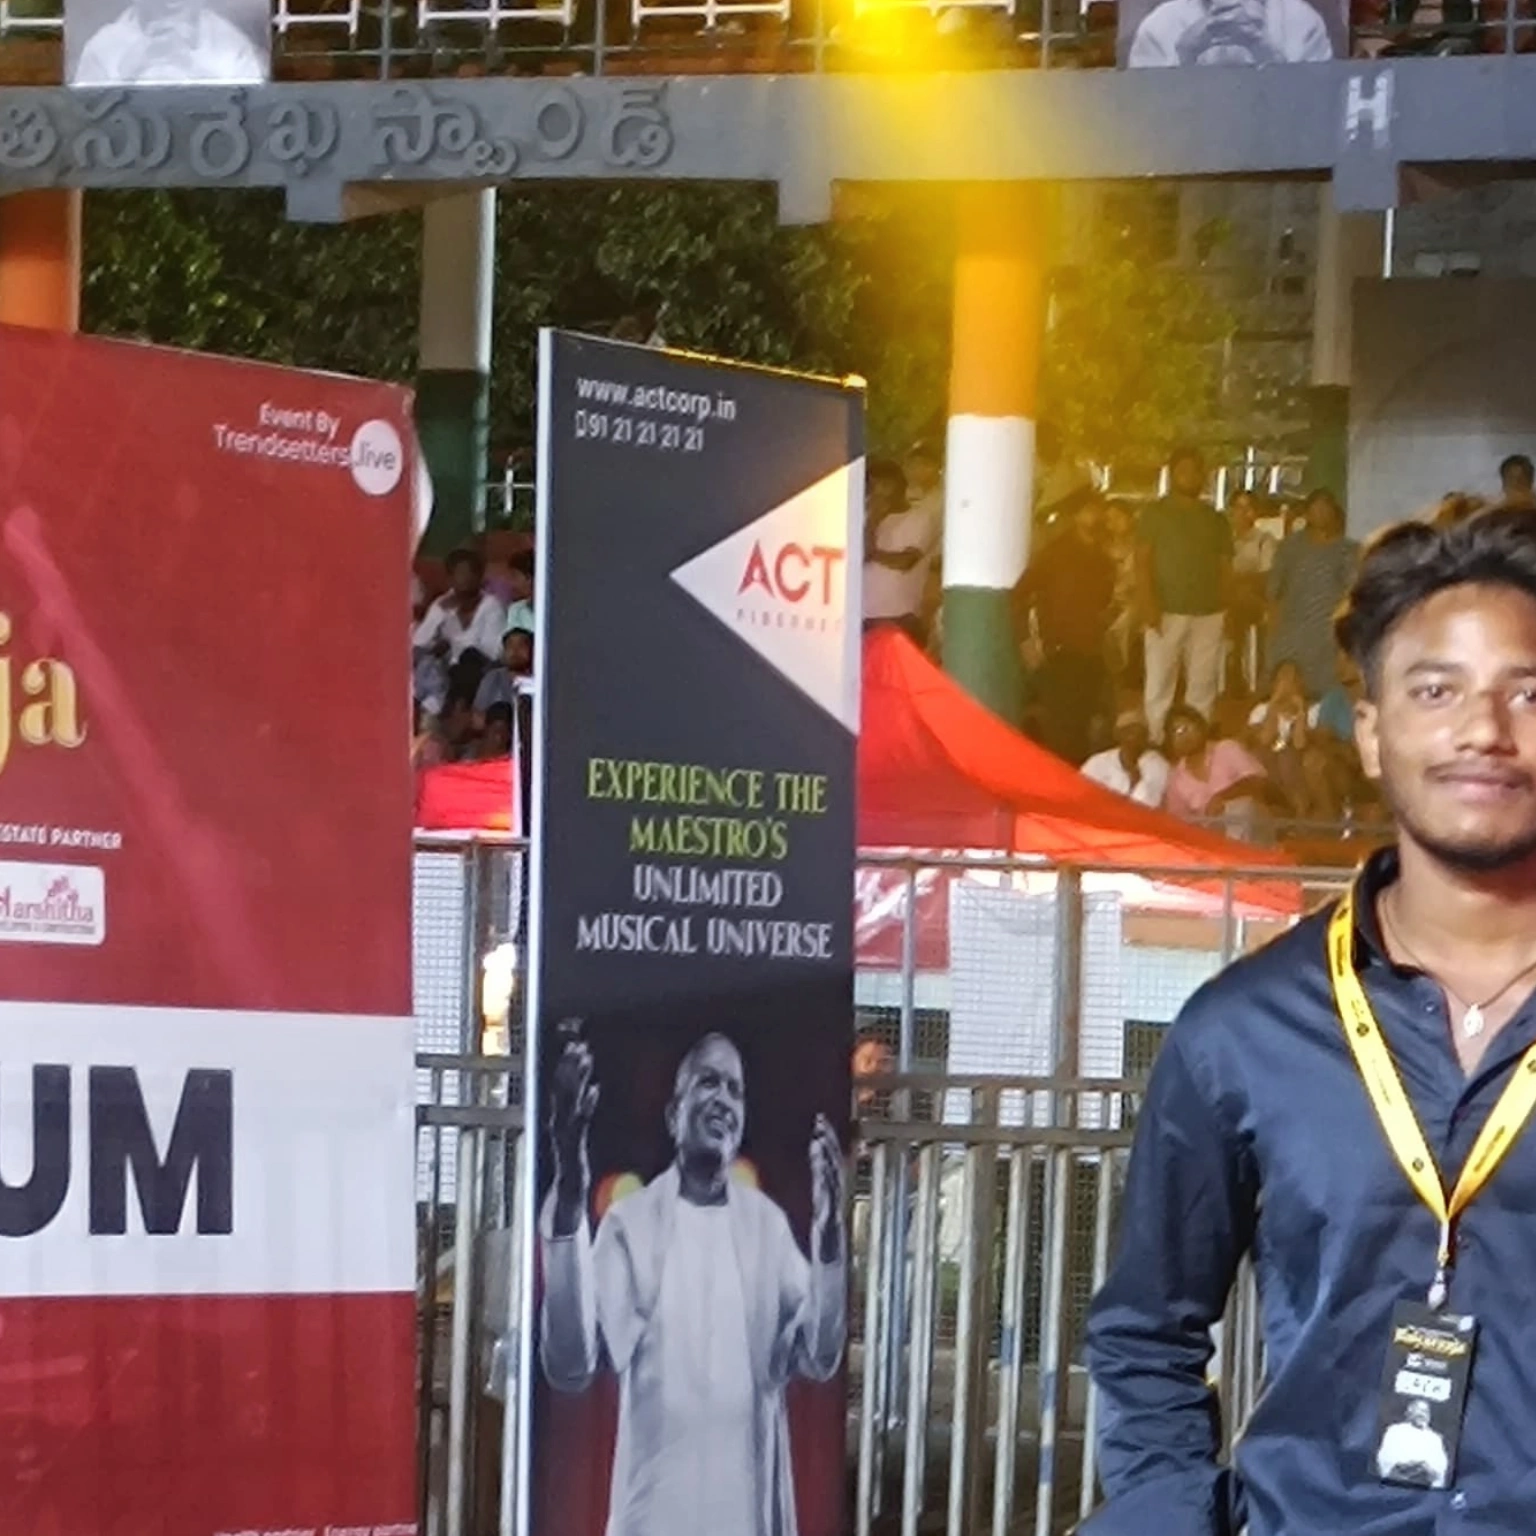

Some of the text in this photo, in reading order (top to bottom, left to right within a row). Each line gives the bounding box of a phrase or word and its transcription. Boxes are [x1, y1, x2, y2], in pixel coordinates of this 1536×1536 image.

[260, 402, 341, 440] Event By
[576, 377, 736, 421] www.actcorp.in
[738, 539, 844, 604] ACT
[587, 758, 828, 813] EXPERIENCE THE
[51, 827, 122, 849] PARTNER
[629, 815, 788, 860] MAESTRO'S
[633, 865, 783, 907] UNLIMITED
[576, 914, 833, 958] MUSICAL UNIVERSE
